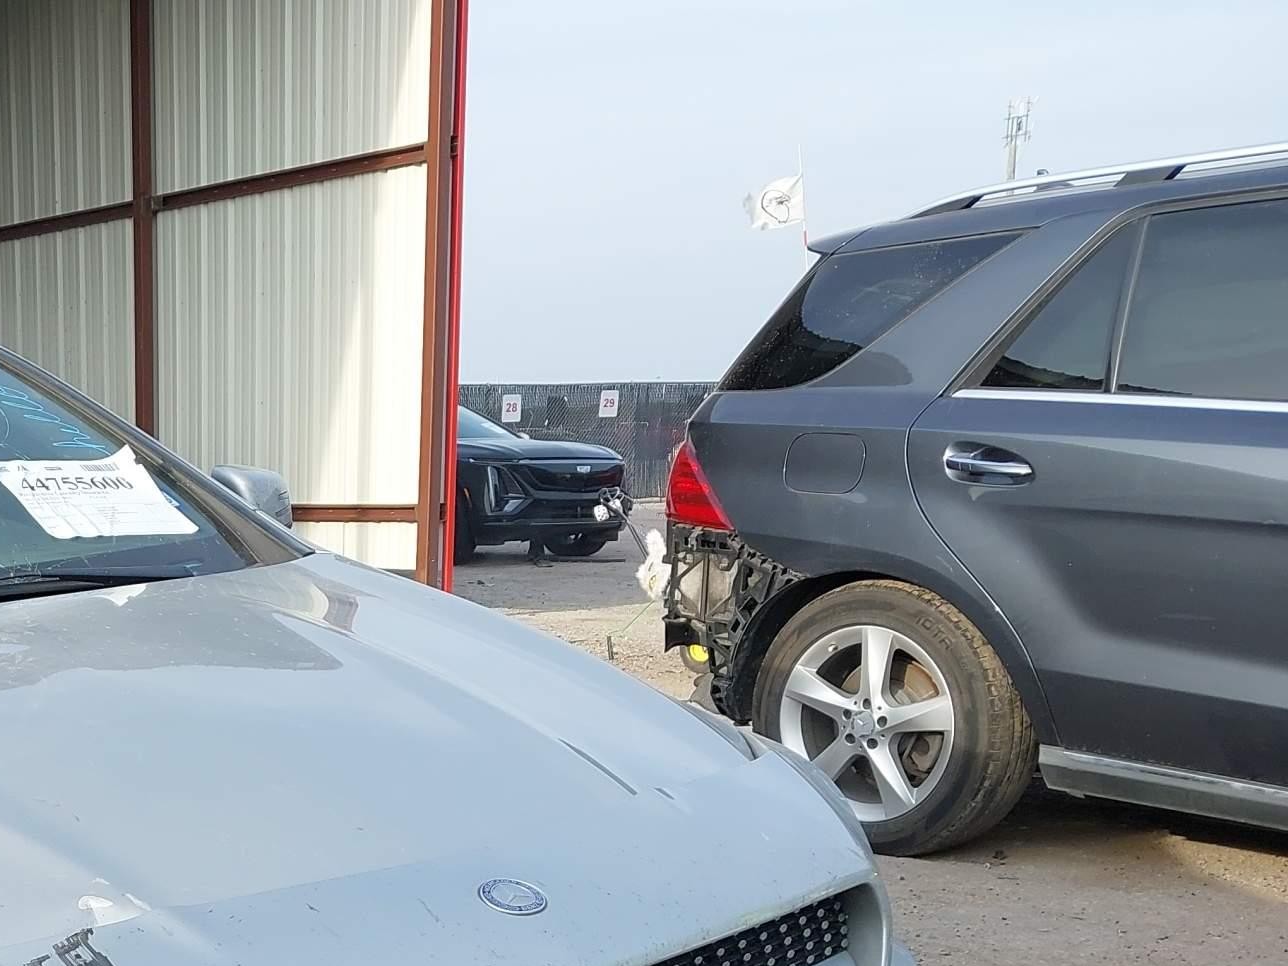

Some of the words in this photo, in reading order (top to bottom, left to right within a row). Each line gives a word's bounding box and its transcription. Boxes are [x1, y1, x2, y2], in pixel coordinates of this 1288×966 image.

[505, 402, 518, 413] 28
[603, 398, 615, 408] 29
[20, 475, 134, 492] 44755600
